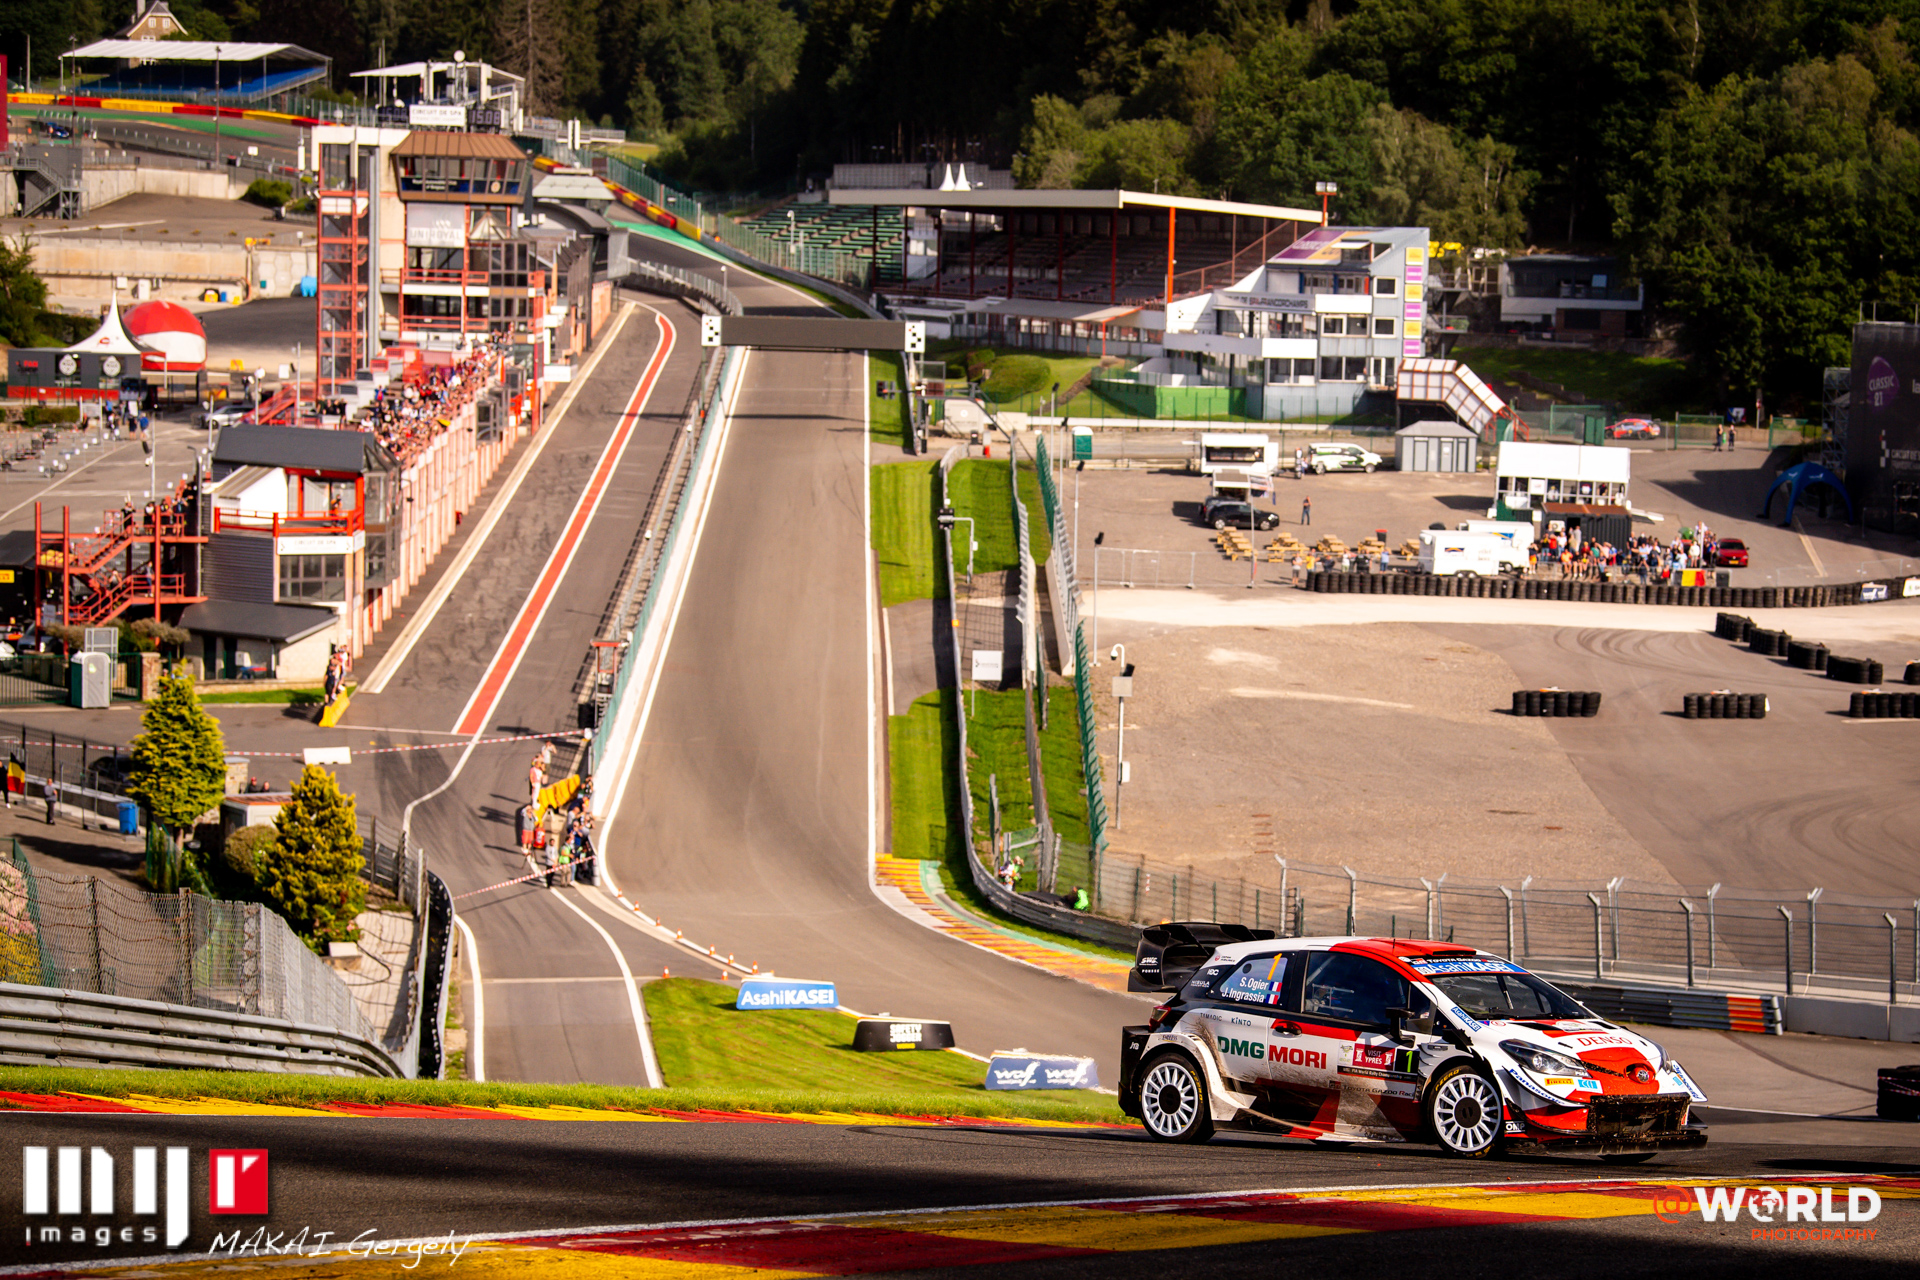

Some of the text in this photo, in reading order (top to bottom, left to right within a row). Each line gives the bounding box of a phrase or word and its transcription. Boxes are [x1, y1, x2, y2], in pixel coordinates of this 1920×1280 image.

[1869, 375, 1894, 391] CLASSIC
[1874, 391, 1883, 406] 21
[1267, 953, 1283, 980] 1
[1428, 961, 1515, 974] AsahiKASEI
[741, 989, 834, 1006] AsahiKASEI
[1452, 1006, 1481, 1032] AsahiKASEI
[890, 1024, 922, 1033] SAFETY
[1576, 1036, 1633, 1047] DENSO
[1217, 1035, 1327, 1070] DMG MORI
[1367, 1049, 1382, 1057] VISIT
[1364, 1056, 1383, 1065] YPRES
[1405, 1050, 1413, 1073] 1
[1508, 1068, 1565, 1106] Panasonic
[1505, 1122, 1525, 1131] OMP
